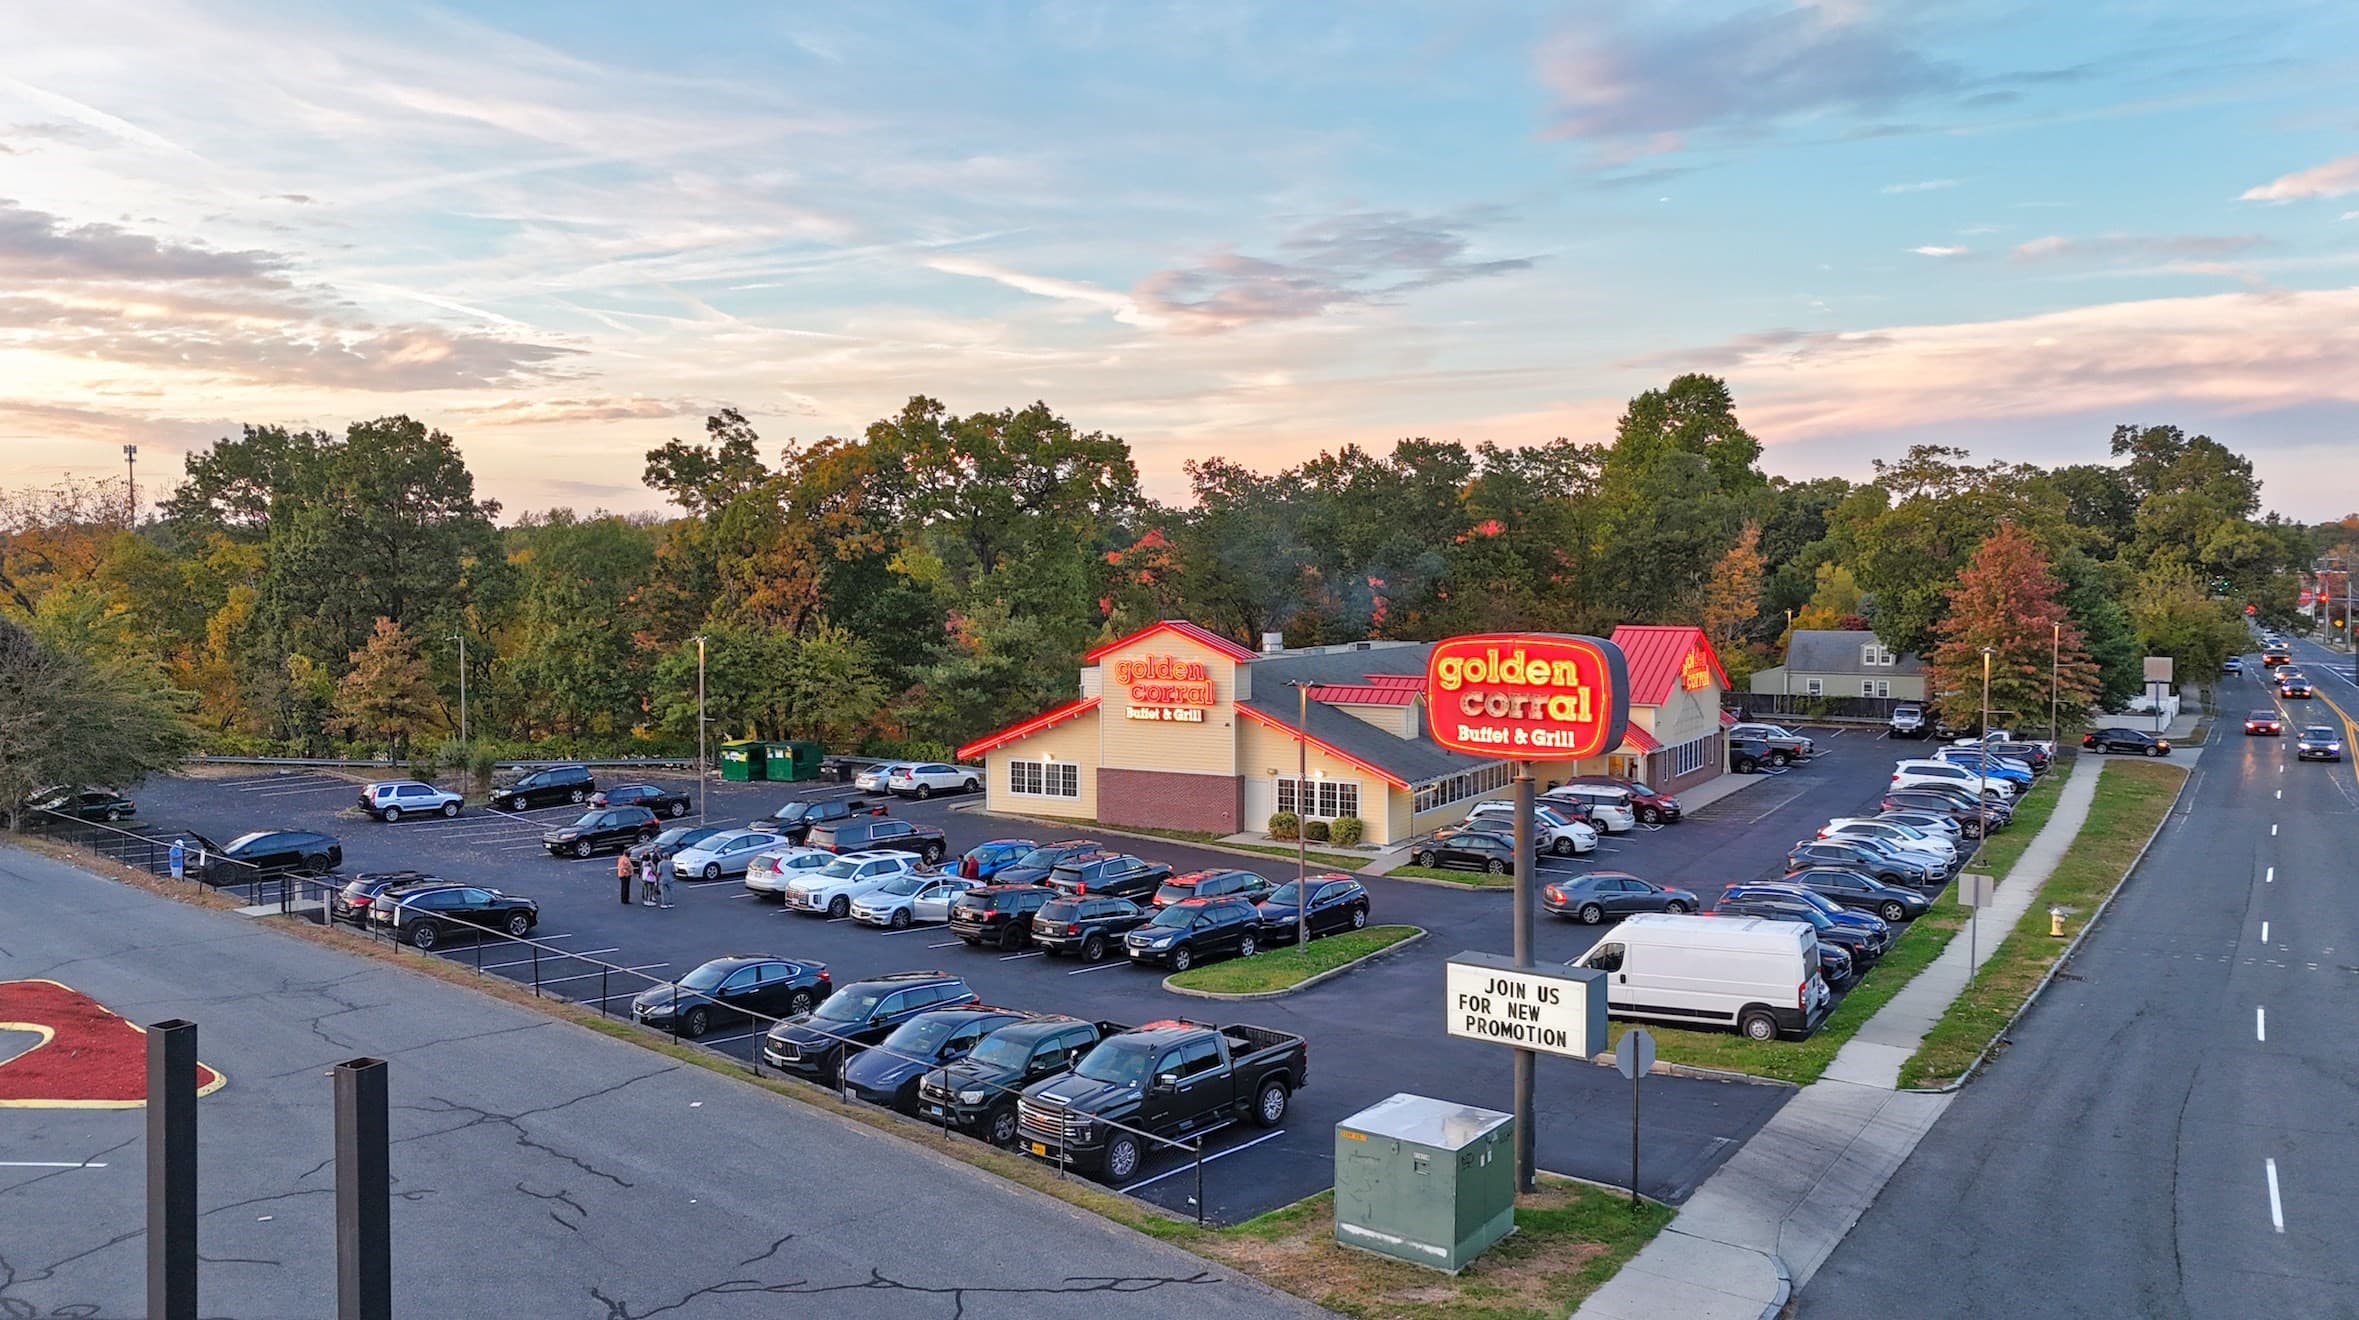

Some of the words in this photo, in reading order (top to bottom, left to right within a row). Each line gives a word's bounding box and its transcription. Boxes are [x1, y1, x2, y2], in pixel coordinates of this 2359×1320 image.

[1115, 654, 1206, 684] golden
[1437, 648, 1579, 690] golden
[1131, 679, 1216, 706] corral
[1459, 686, 1593, 723] corral
[1126, 706, 1160, 720] Buffet
[1162, 707, 1172, 721] &
[1173, 708, 1203, 722] Grill
[1457, 724, 1510, 745] Buffet
[1513, 727, 1529, 745] &
[1531, 729, 1576, 748] Grill
[1484, 978, 1526, 1000] JOIN
[1537, 985, 1561, 1005] US
[1459, 993, 1492, 1015] FOR
[1507, 1003, 1541, 1023] NEW
[1466, 1015, 1568, 1048] PROMOTION
